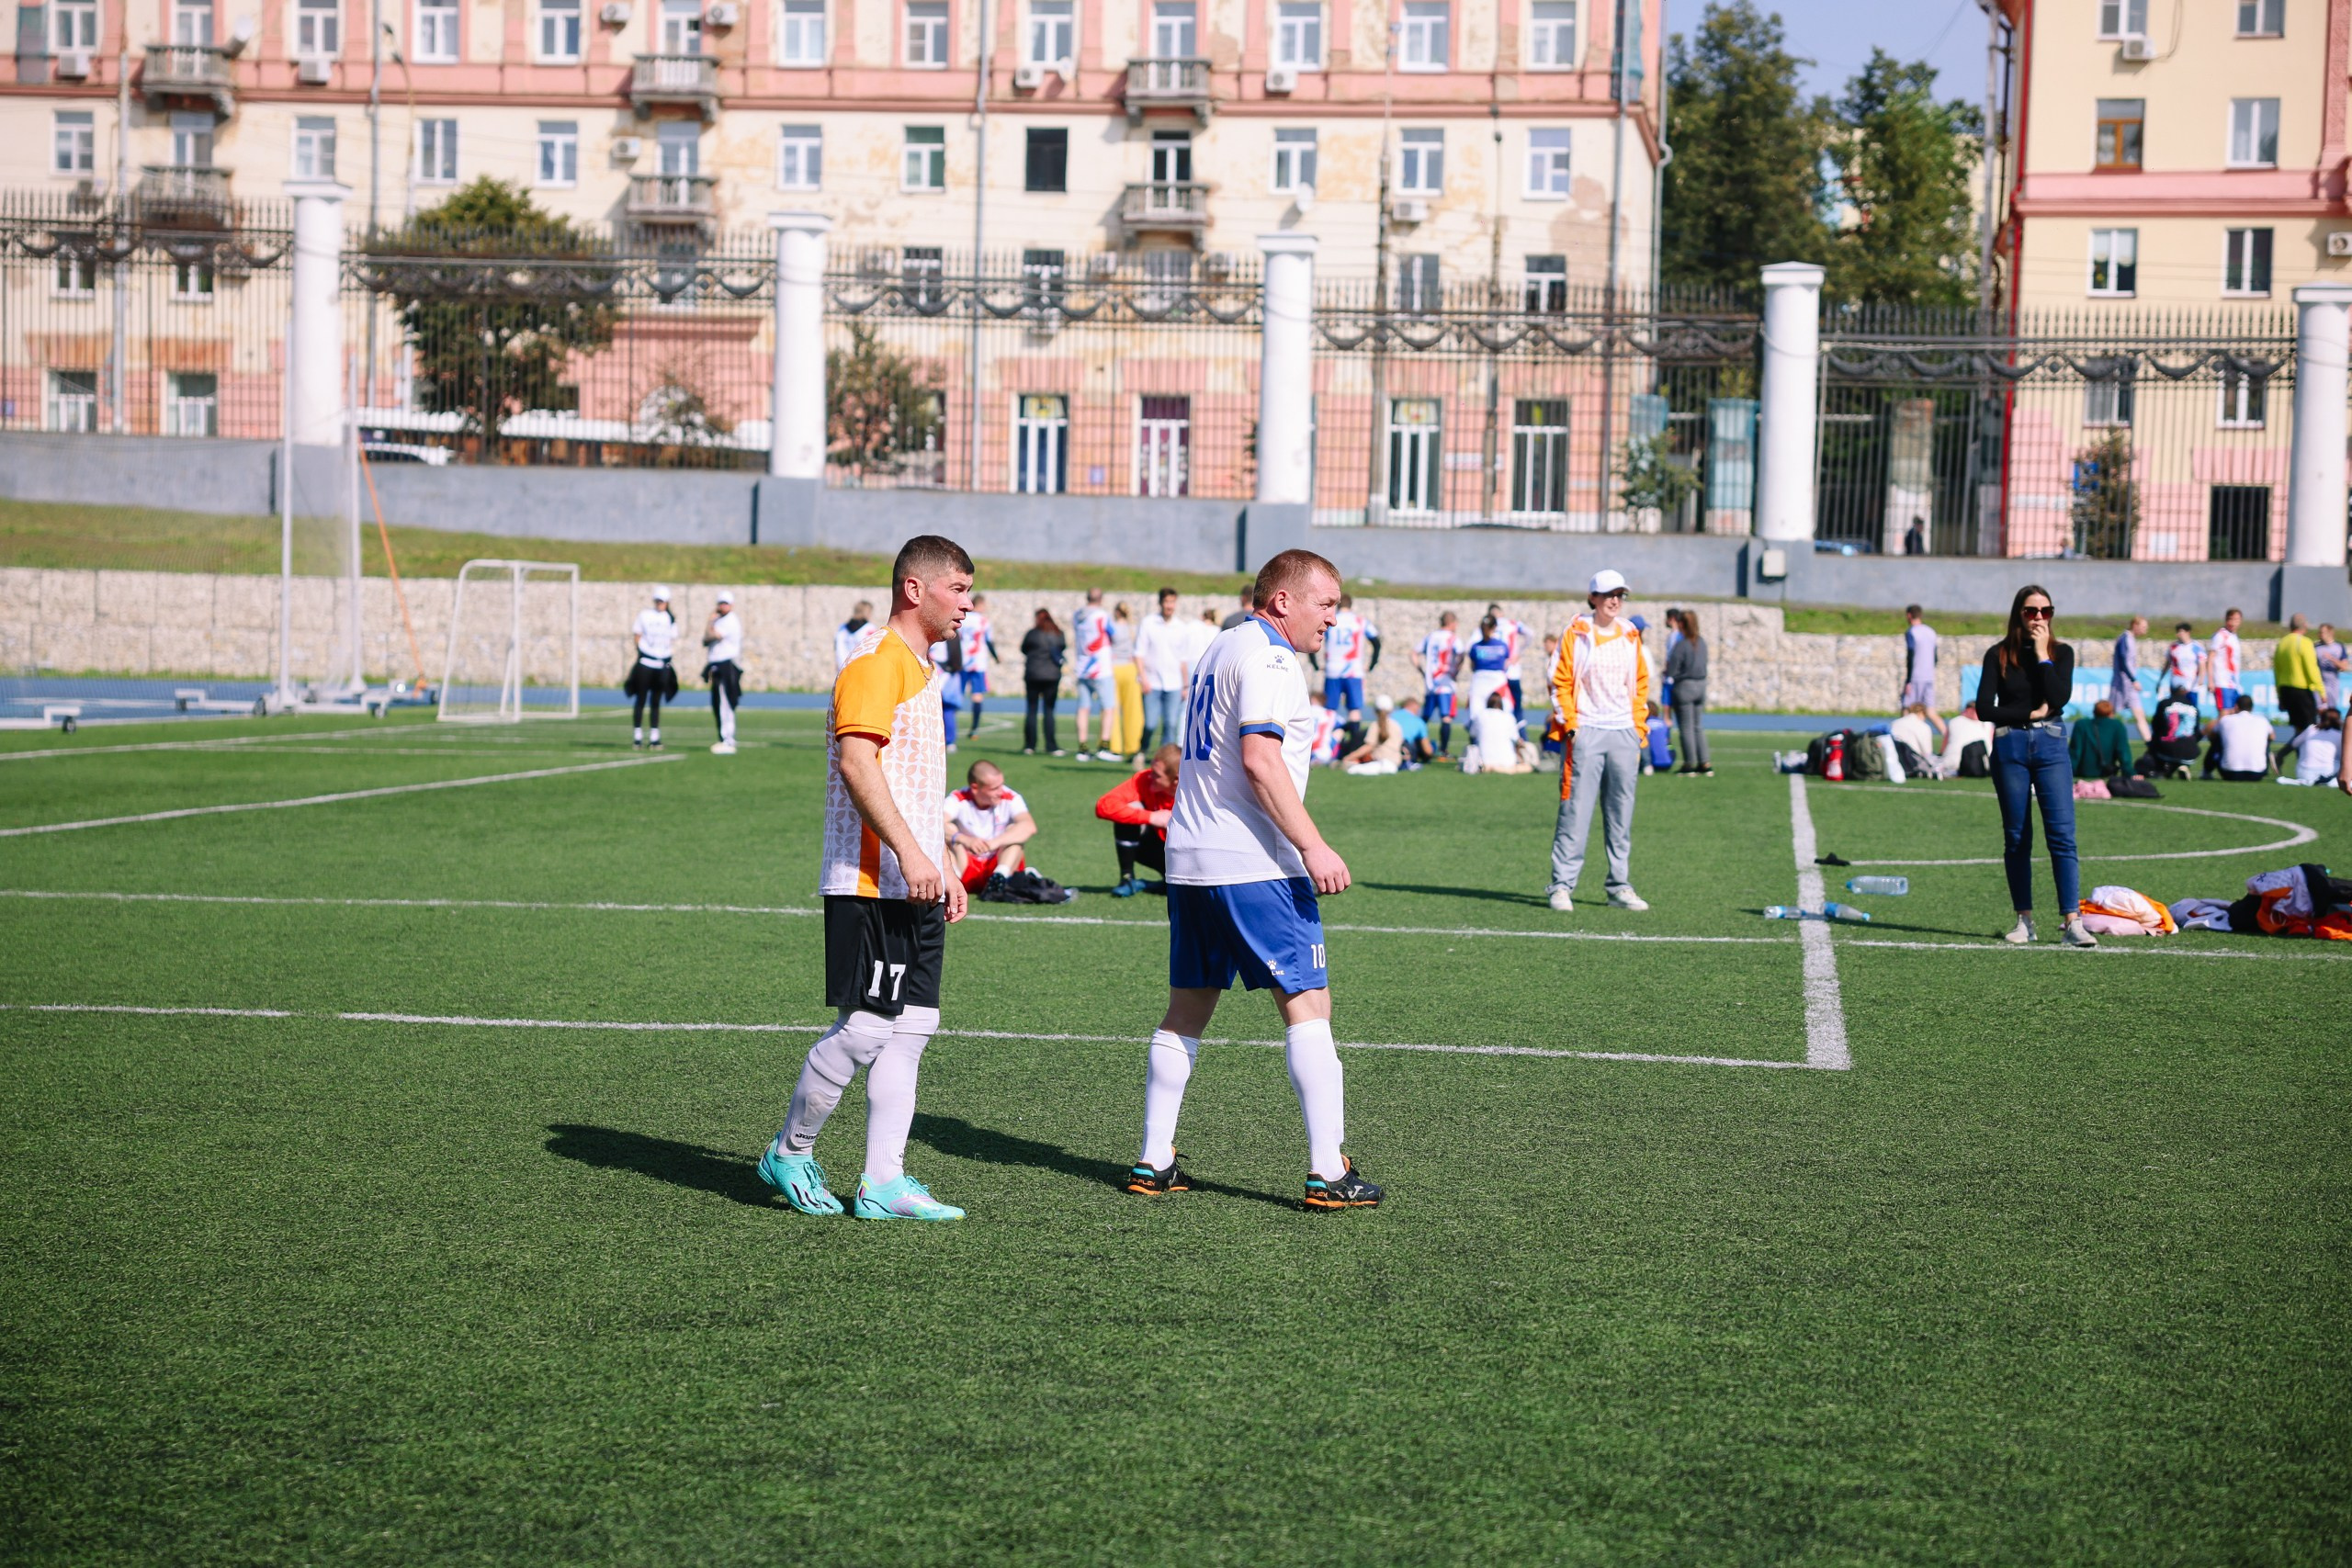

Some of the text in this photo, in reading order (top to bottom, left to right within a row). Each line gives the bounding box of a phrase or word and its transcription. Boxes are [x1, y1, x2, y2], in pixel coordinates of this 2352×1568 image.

[1185, 673, 1215, 761] 10
[1310, 944, 1326, 969] 10
[868, 960, 906, 1000] 17
